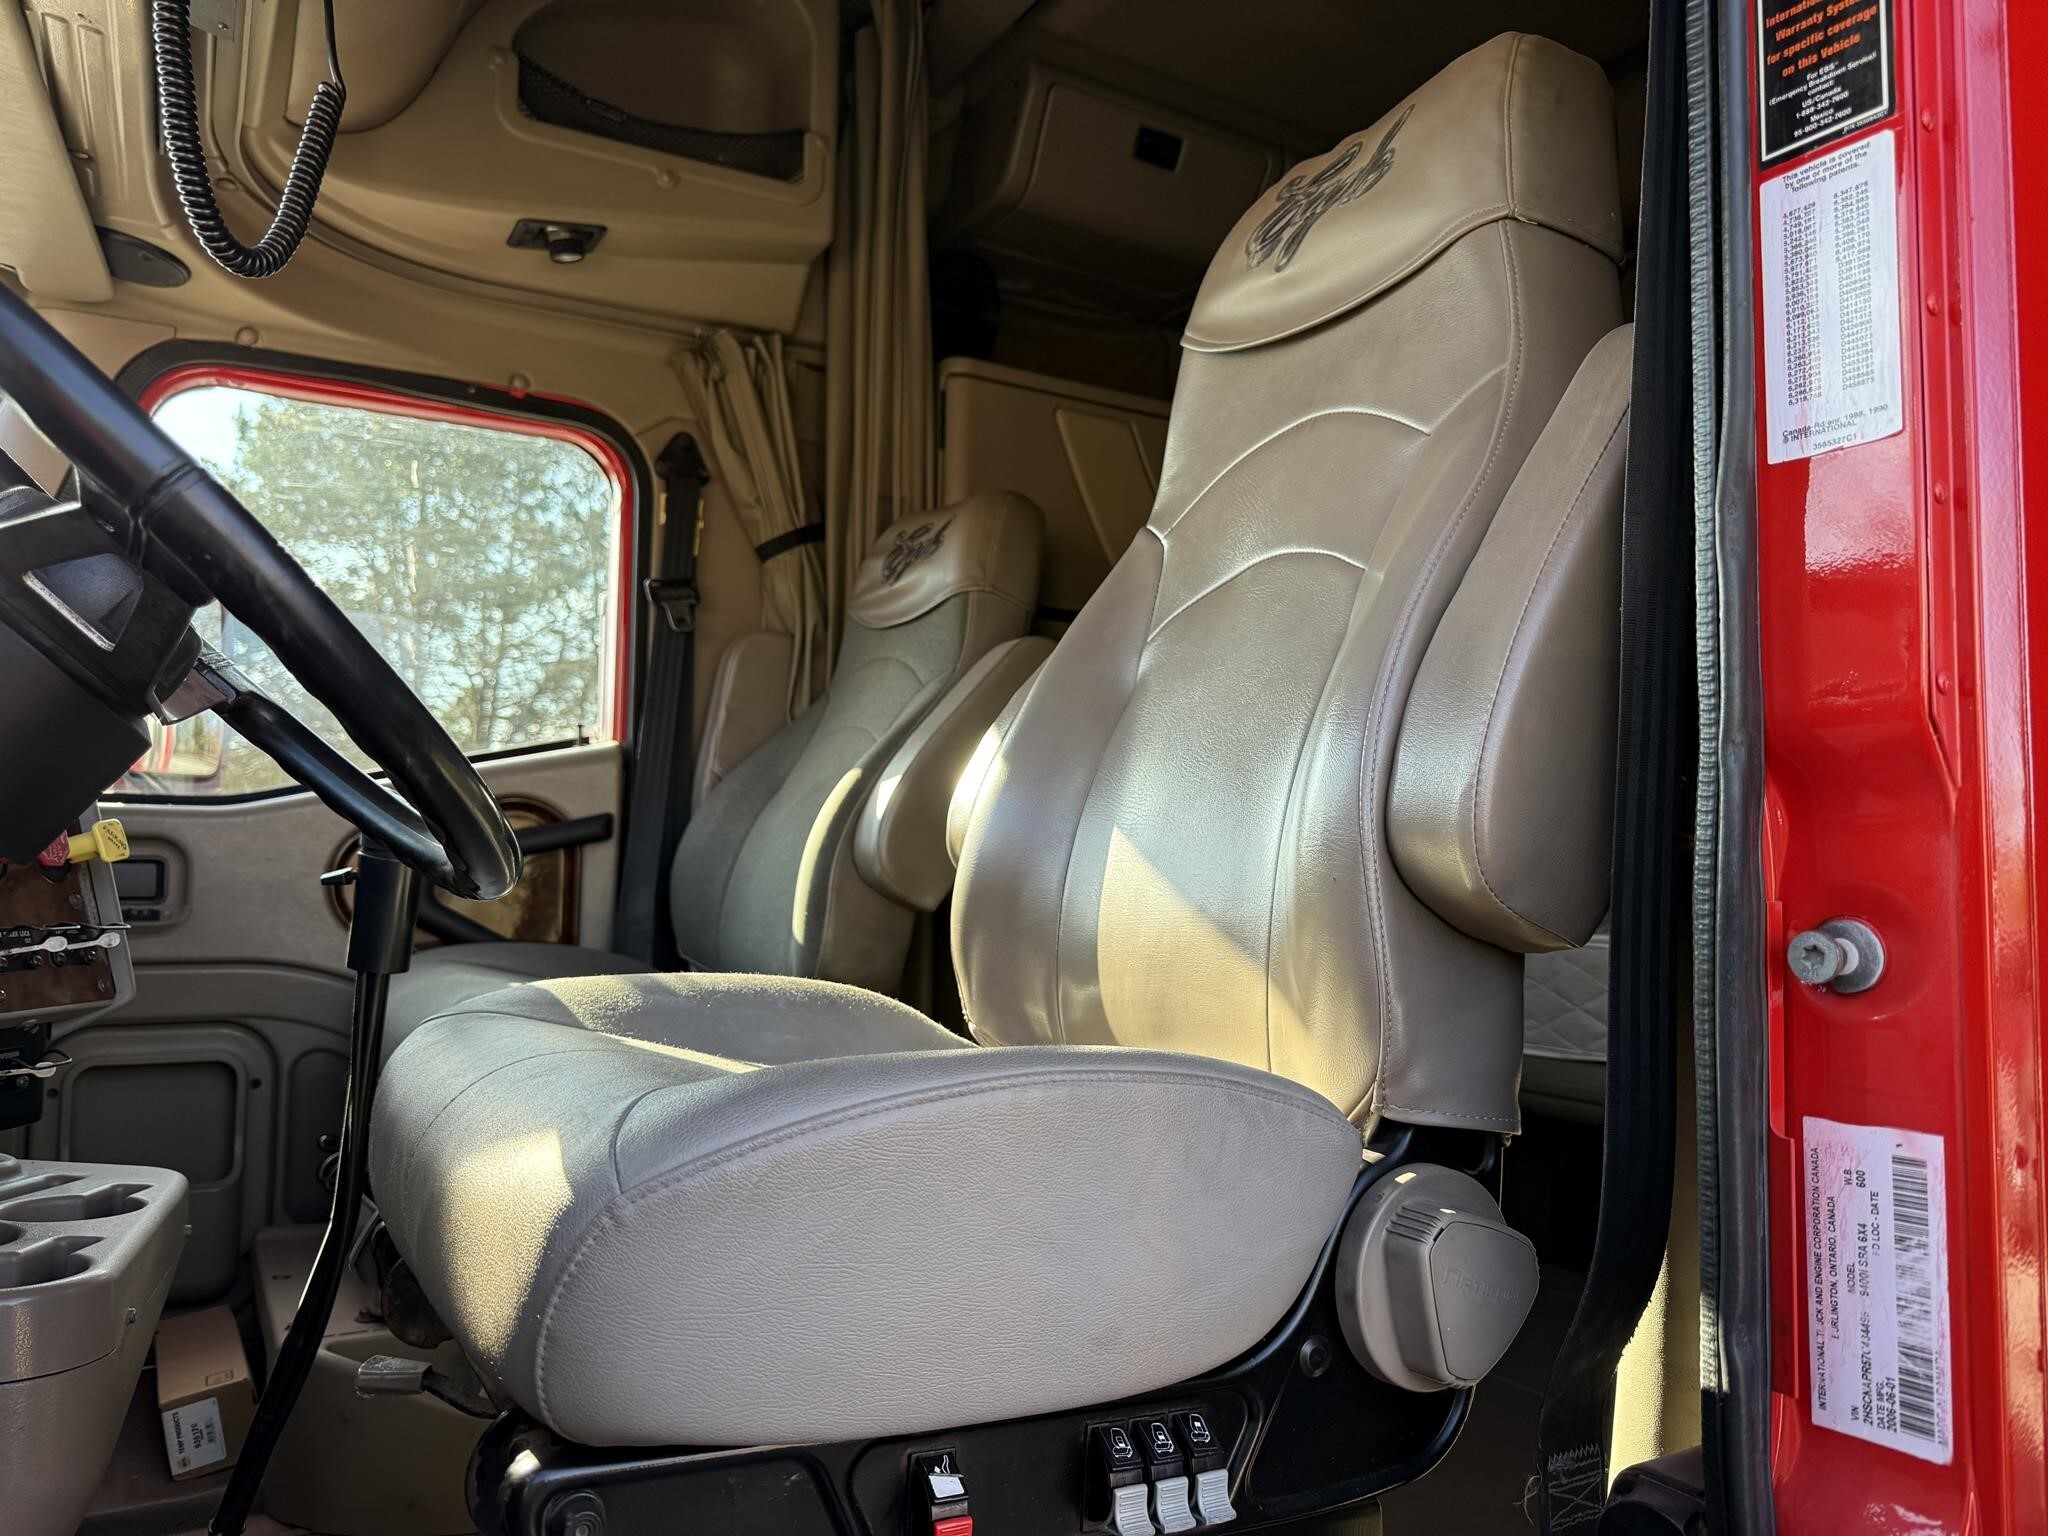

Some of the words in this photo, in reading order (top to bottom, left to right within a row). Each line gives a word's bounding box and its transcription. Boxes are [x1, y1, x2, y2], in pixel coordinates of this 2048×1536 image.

[1766, 52, 1781, 65] for
[1783, 31, 1825, 57] specific
[1827, 5, 1877, 36] coverage
[1776, 11, 1824, 41] Warranty
[1782, 65, 1795, 77] on
[1798, 54, 1818, 70] this
[1820, 33, 1861, 58] Vehicle
[1806, 72, 1818, 81] For
[1768, 84, 1808, 106] (Emergency
[1809, 108, 1834, 123] Mexico
[1782, 173, 1798, 183] This
[1799, 161, 1827, 176] vehicle
[1828, 156, 1836, 164] is
[1837, 141, 1870, 160] covered
[1784, 182, 1794, 190] by
[1795, 174, 1810, 183] one
[1822, 161, 1843, 173] more
[1844, 156, 1853, 165] of
[1854, 151, 1868, 160] the
[1791, 176, 1827, 193] following
[1782, 425, 1812, 437] Canada
[1869, 403, 1888, 414] 1990
[1790, 419, 1857, 442] INTERNATIONAL
[1810, 1147, 1820, 1183] CANADA
[1855, 1170, 1866, 1188] 600
[1811, 1186, 1822, 1250] CORPORATION
[1826, 1196, 1837, 1232] CANADA
[1870, 1190, 1880, 1216] DATE
[1857, 1222, 1868, 1243] 6X4
[1871, 1222, 1880, 1242] LOC
[1813, 1251, 1823, 1284] ENGINE
[1828, 1235, 1838, 1277] ONTARIO,
[1858, 1245, 1868, 1269] SRA
[1814, 1284, 1824, 1301] AND
[1846, 1262, 1856, 1294] MODEL
[1815, 1339, 1827, 1411] INTERNATIONAL
[1850, 1405, 1860, 1421] VIN
[1876, 1406, 1886, 1430] DATE
[1886, 1376, 1898, 1434] 2006-06-01
